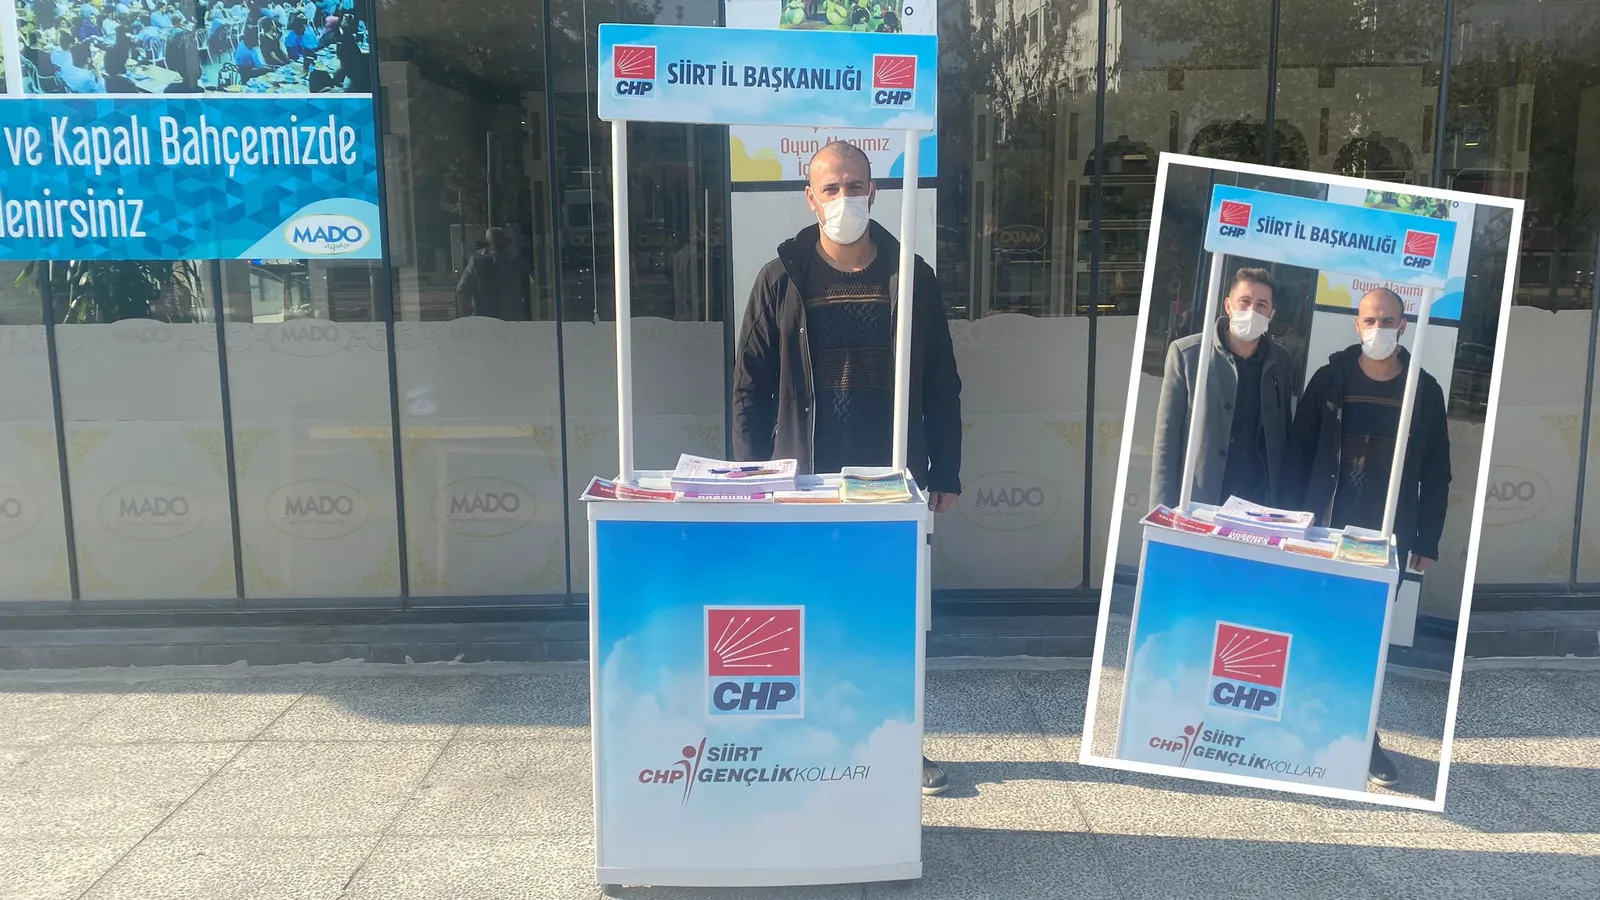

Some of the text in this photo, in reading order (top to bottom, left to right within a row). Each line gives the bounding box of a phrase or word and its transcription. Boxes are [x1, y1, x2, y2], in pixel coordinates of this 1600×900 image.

[667, 60, 862, 92] SİİRT İL BAŞKANLIĞI
[616, 80, 653, 96] CHP
[874, 90, 912, 105] CHP
[4, 114, 356, 177] ve Kapalı Bahçemizde
[780, 138, 819, 156] Oyun
[293, 225, 362, 242] MADO
[1219, 225, 1245, 238] CHP
[1256, 216, 1397, 255] SİİRT İL BAŞKANLIĞI
[1403, 255, 1432, 269] CHP
[1384, 281, 1424, 297] Alanımı
[281, 324, 339, 342] MADO
[975, 486, 1045, 508] MADO
[1485, 480, 1536, 501] ADO
[119, 496, 189, 518] MADO
[284, 494, 354, 516] MADO
[449, 492, 520, 514] MADO
[713, 681, 796, 711] CHP
[1213, 681, 1277, 711] CHP
[1149, 736, 1184, 753] CHP
[1202, 729, 1245, 748] SİİRT
[707, 743, 763, 762] SİİRT
[638, 769, 684, 784] CHP
